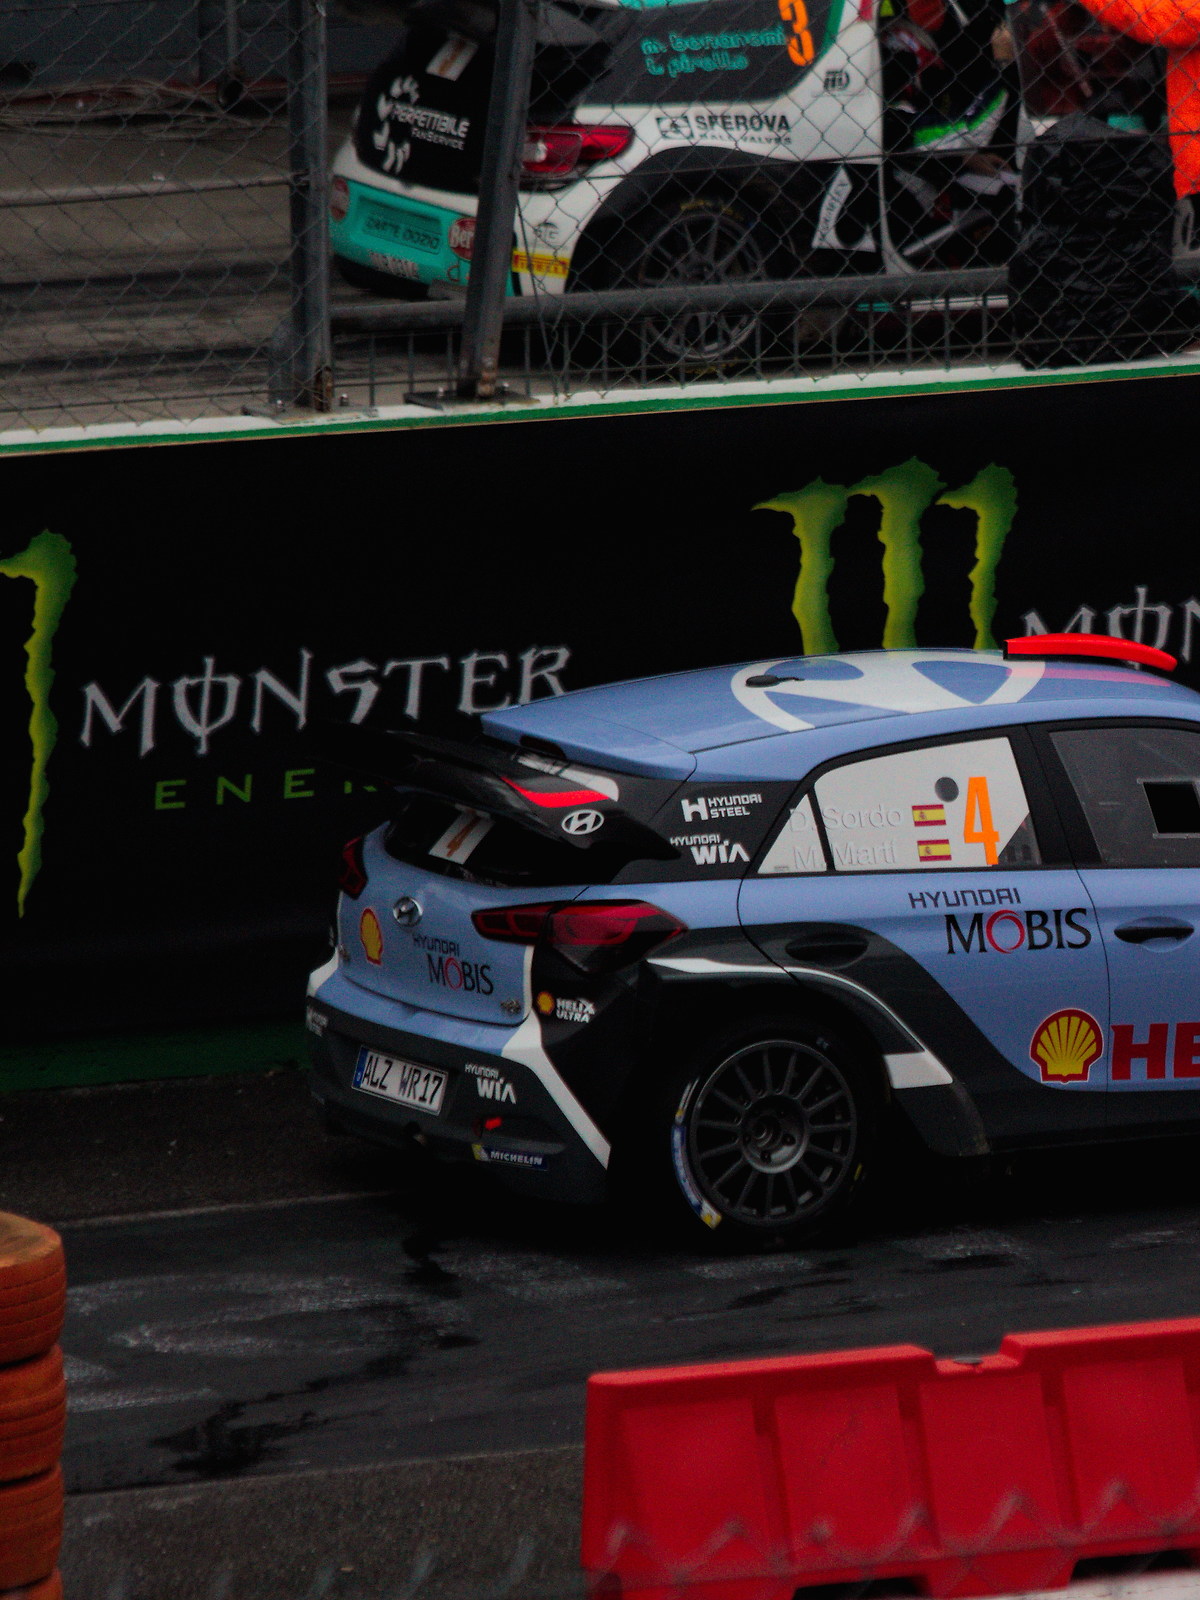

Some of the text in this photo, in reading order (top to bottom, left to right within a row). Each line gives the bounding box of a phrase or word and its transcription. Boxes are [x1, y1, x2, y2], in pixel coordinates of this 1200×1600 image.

[778, 0, 815, 66] 3
[77, 643, 574, 759] MONSTER
[708, 793, 763, 808] HYUNDAI
[710, 806, 752, 819] STEEL
[963, 776, 1000, 866] 4
[669, 833, 721, 847] HYUNDAI
[908, 888, 1022, 909] HYUNDAI
[413, 933, 460, 957] HYUNDAI
[944, 907, 1092, 955] MOBIS
[427, 952, 495, 996] MOBIS
[362, 1055, 444, 1105] ALZ WR17
[490, 1150, 544, 1166] MICHELIN
